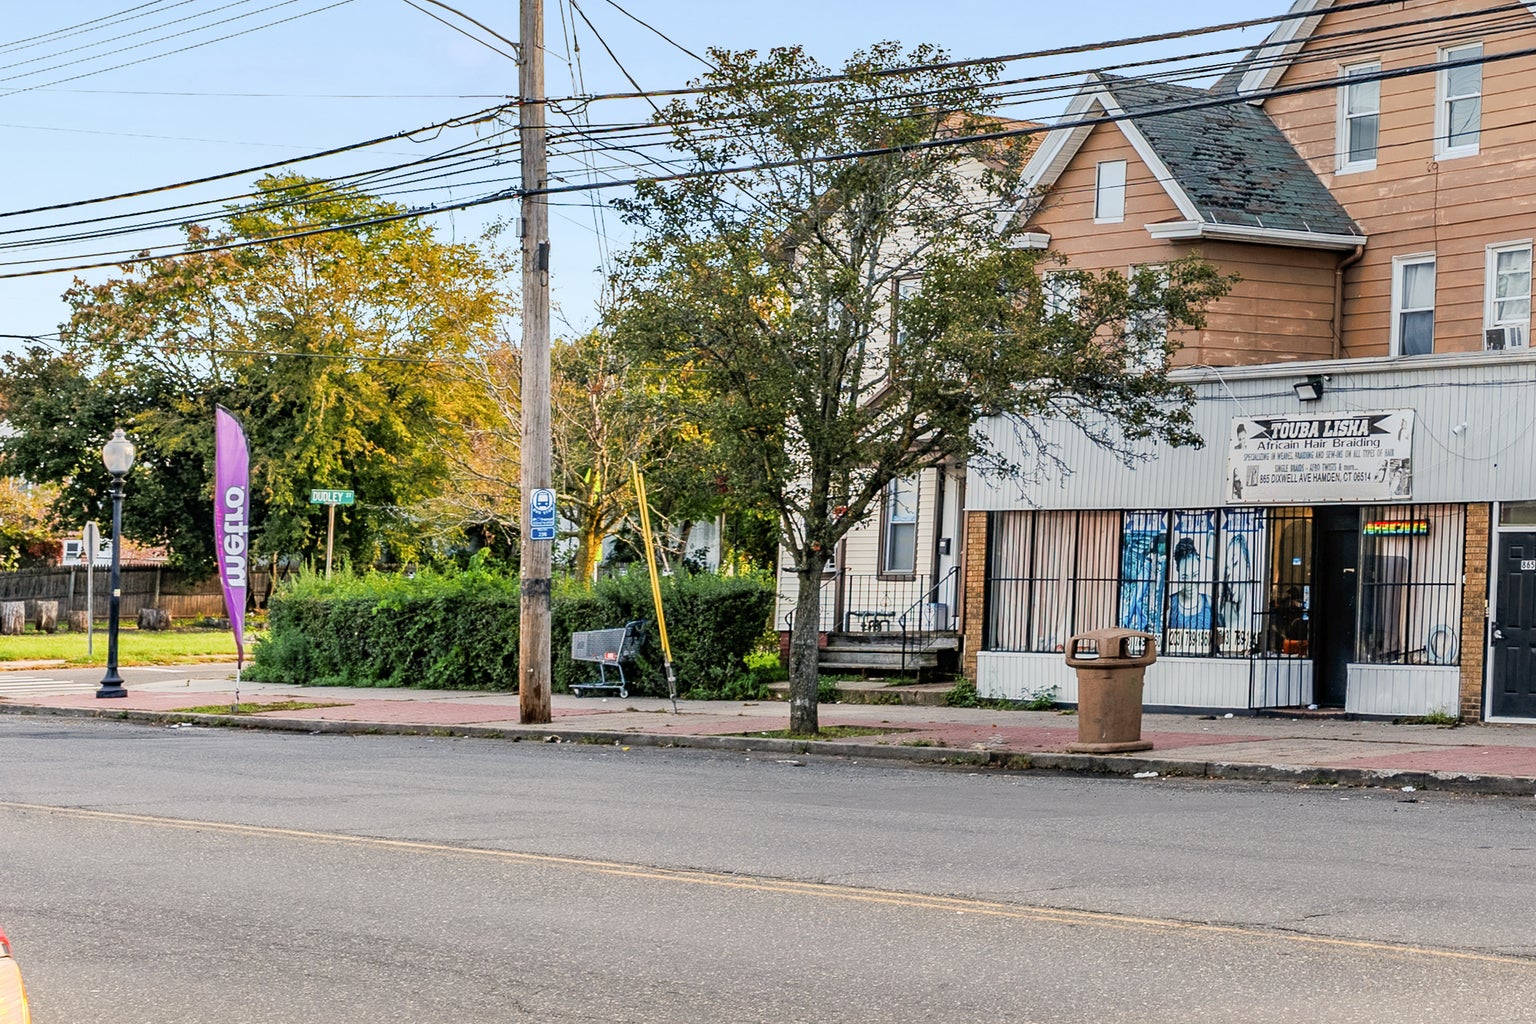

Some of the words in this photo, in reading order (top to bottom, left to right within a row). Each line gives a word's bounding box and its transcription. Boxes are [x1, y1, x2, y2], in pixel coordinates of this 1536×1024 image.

[1271, 420, 1319, 440] TOUBA
[1322, 419, 1369, 437] LISHA
[1257, 440, 1300, 450] Africain
[1304, 439, 1328, 449] Hair
[1333, 438, 1380, 449] Braiding
[1315, 450, 1324, 459] AND
[1353, 449, 1361, 458] ALL
[1363, 448, 1375, 457] TYPES
[1377, 448, 1382, 457] OF
[1260, 474, 1270, 483] 865
[1271, 473, 1297, 483] DIXWELL
[1300, 473, 1311, 483] AVE
[1313, 472, 1342, 483] HAMDEN,
[1343, 472, 1352, 482] CT
[1353, 471, 1371, 482] 06514
[313, 491, 344, 502] DUDLEY
[1521, 561, 1535, 569] 865
